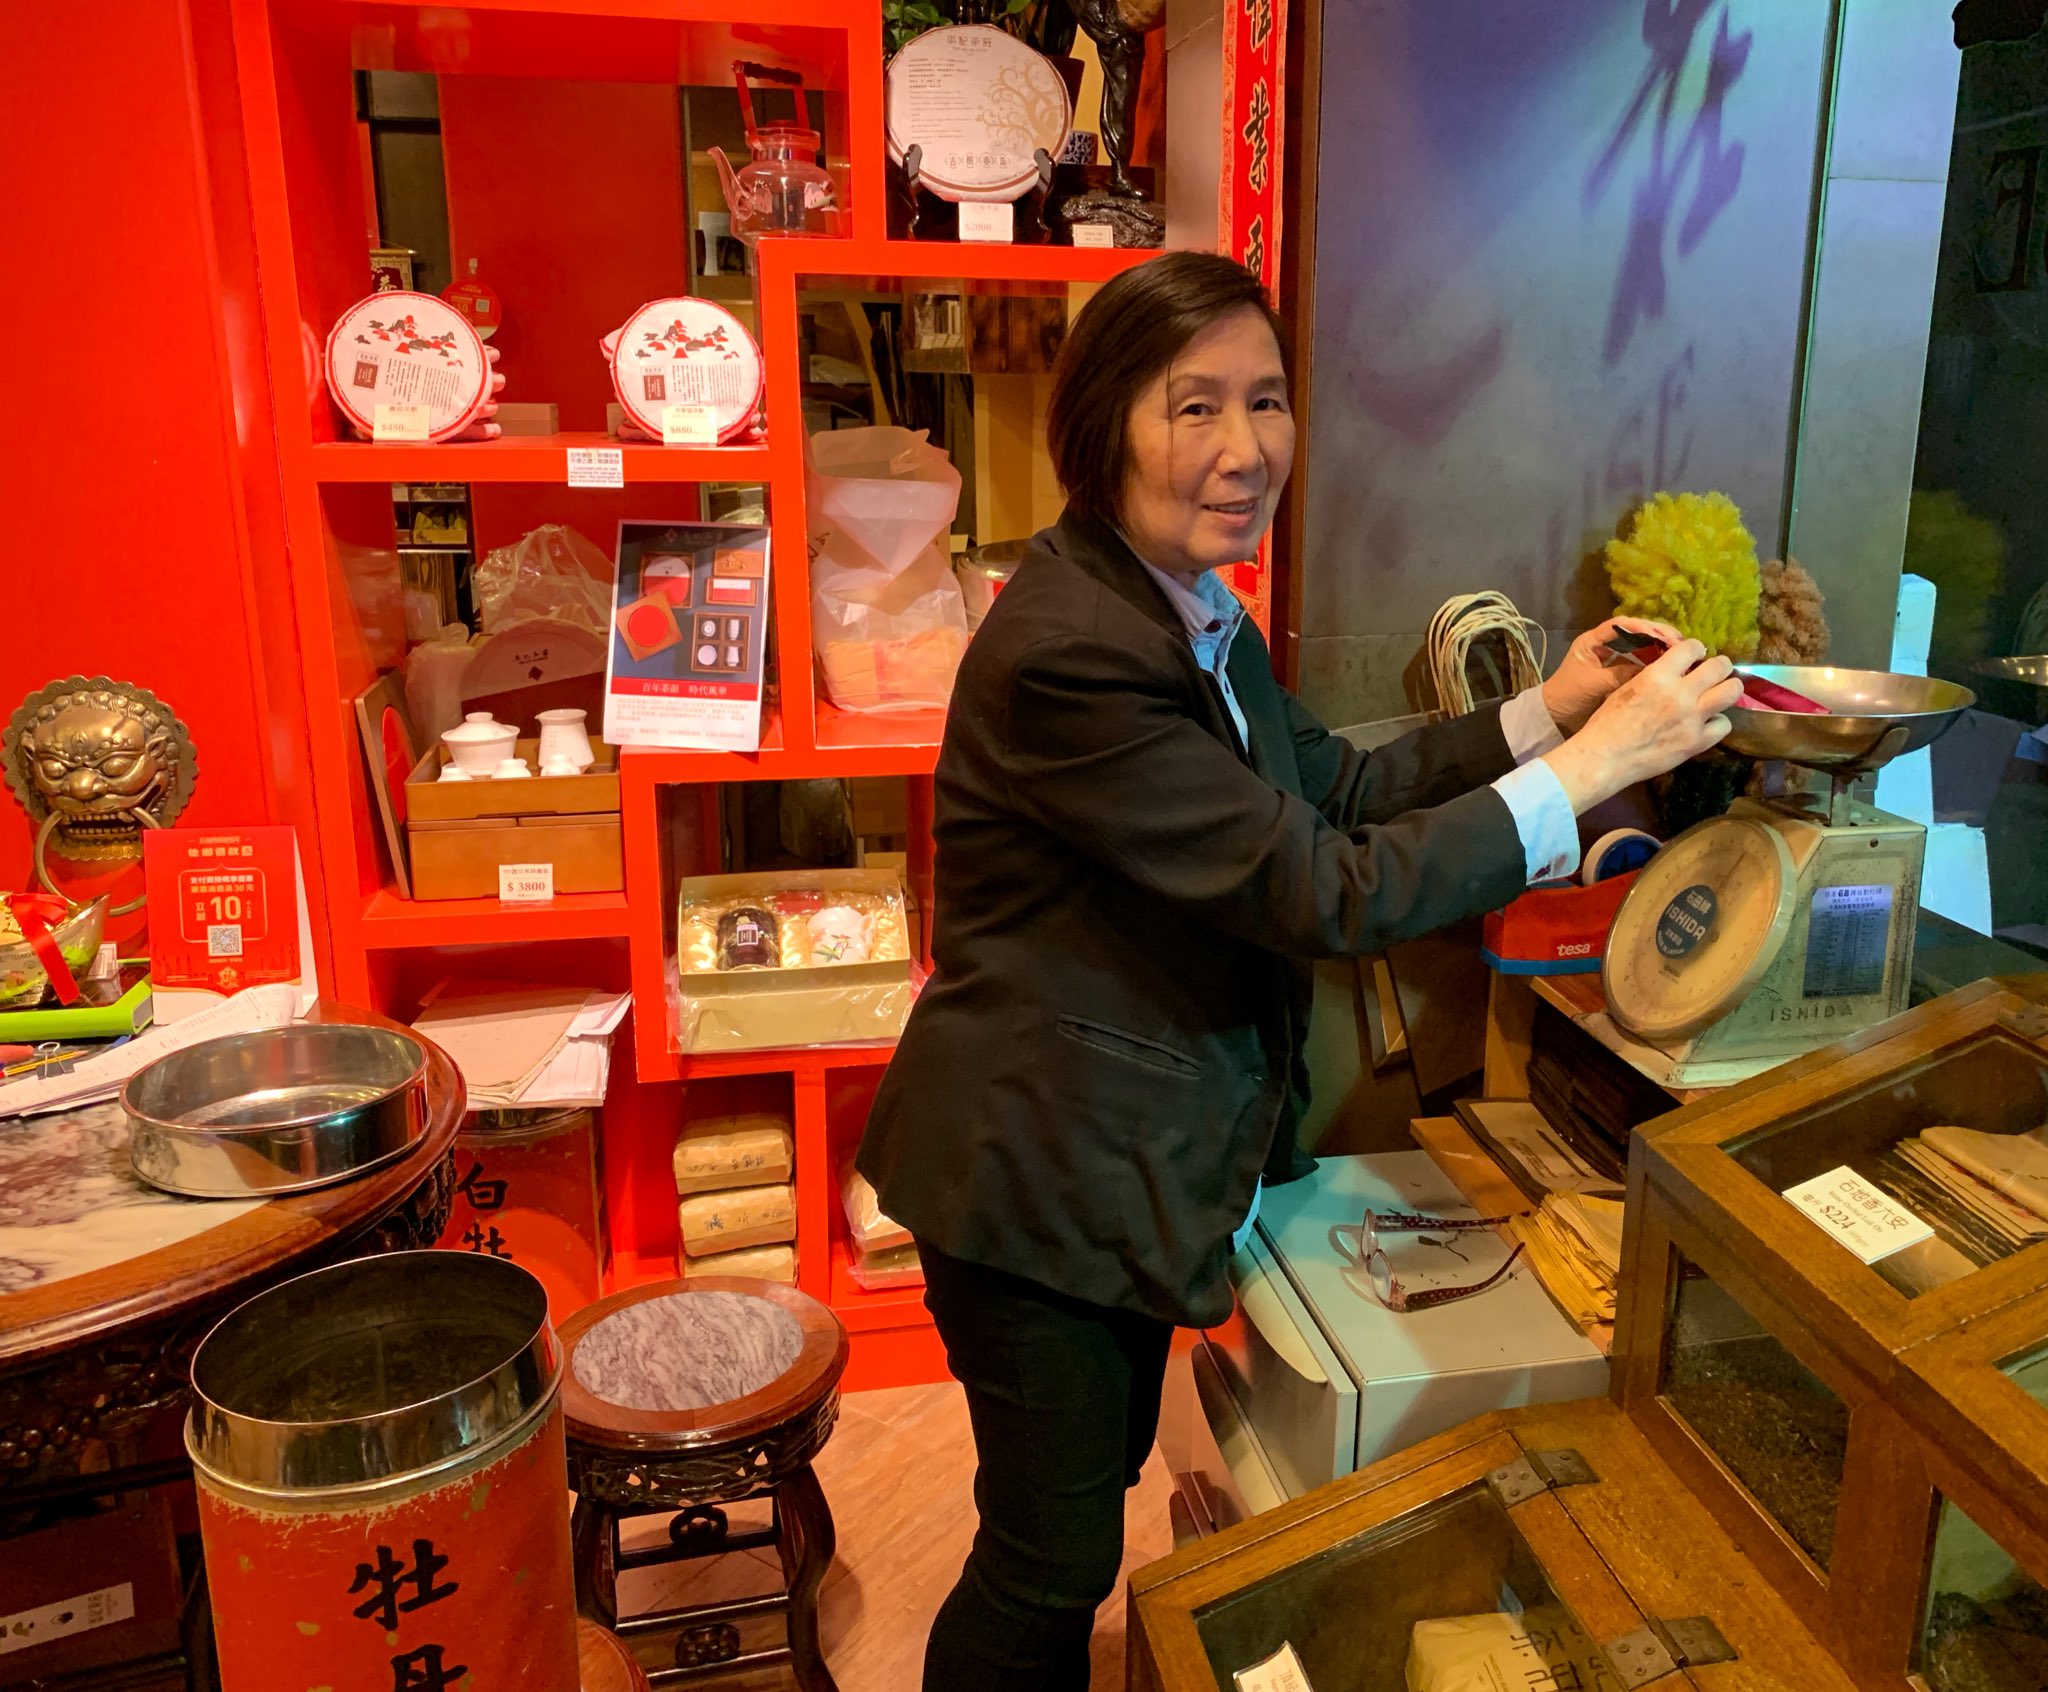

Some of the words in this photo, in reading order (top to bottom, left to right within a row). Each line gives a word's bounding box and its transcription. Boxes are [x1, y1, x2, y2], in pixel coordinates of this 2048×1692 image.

[518, 882, 546, 891] 3800
[210, 895, 242, 921] 10
[1665, 903, 1706, 941] ISHIDA
[1557, 943, 1591, 956] tesa
[1770, 1004, 1853, 1022] ISHIDA
[1820, 1204, 1857, 1230] $224
